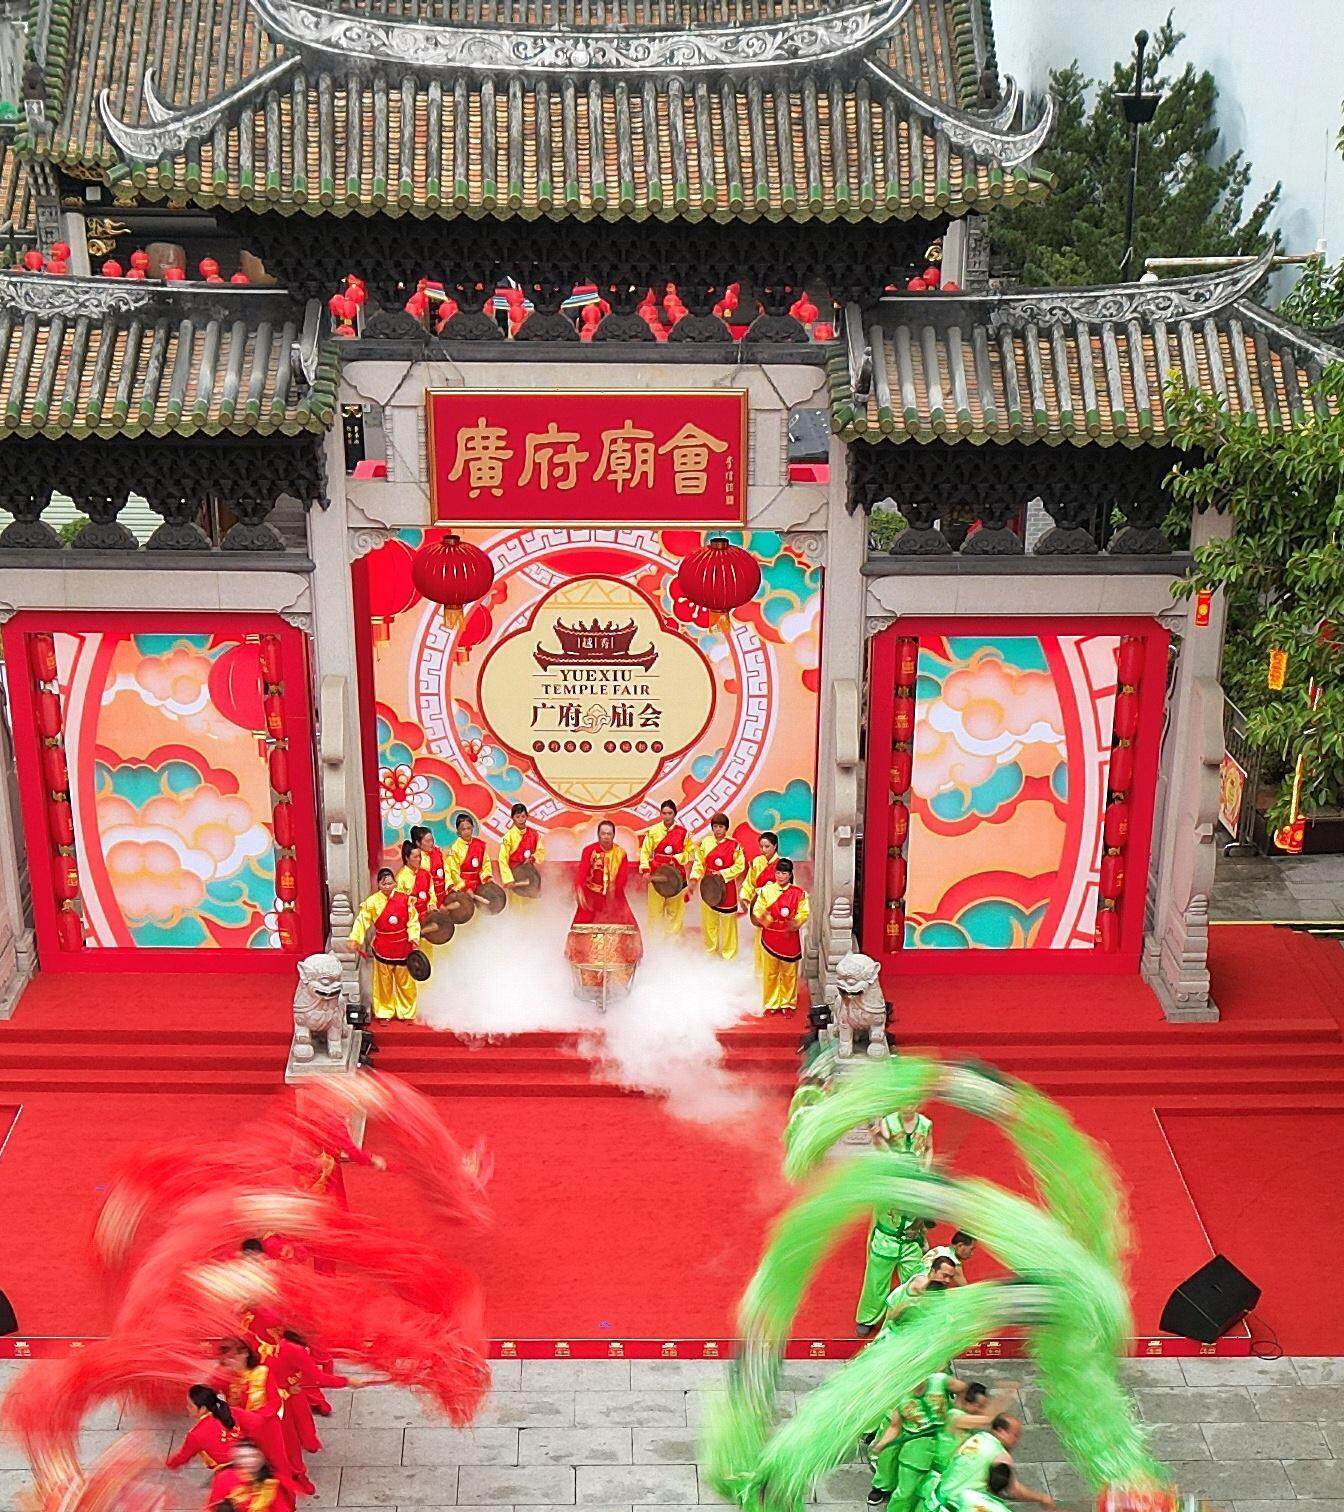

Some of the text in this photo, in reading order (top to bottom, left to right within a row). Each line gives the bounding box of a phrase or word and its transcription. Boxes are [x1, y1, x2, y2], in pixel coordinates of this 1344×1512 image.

[448, 417, 728, 498] 廣府廟會
[560, 669, 632, 682] YUEXIU
[542, 684, 650, 696] TEMPLE FAIR
[530, 702, 663, 728] 广府庙会
